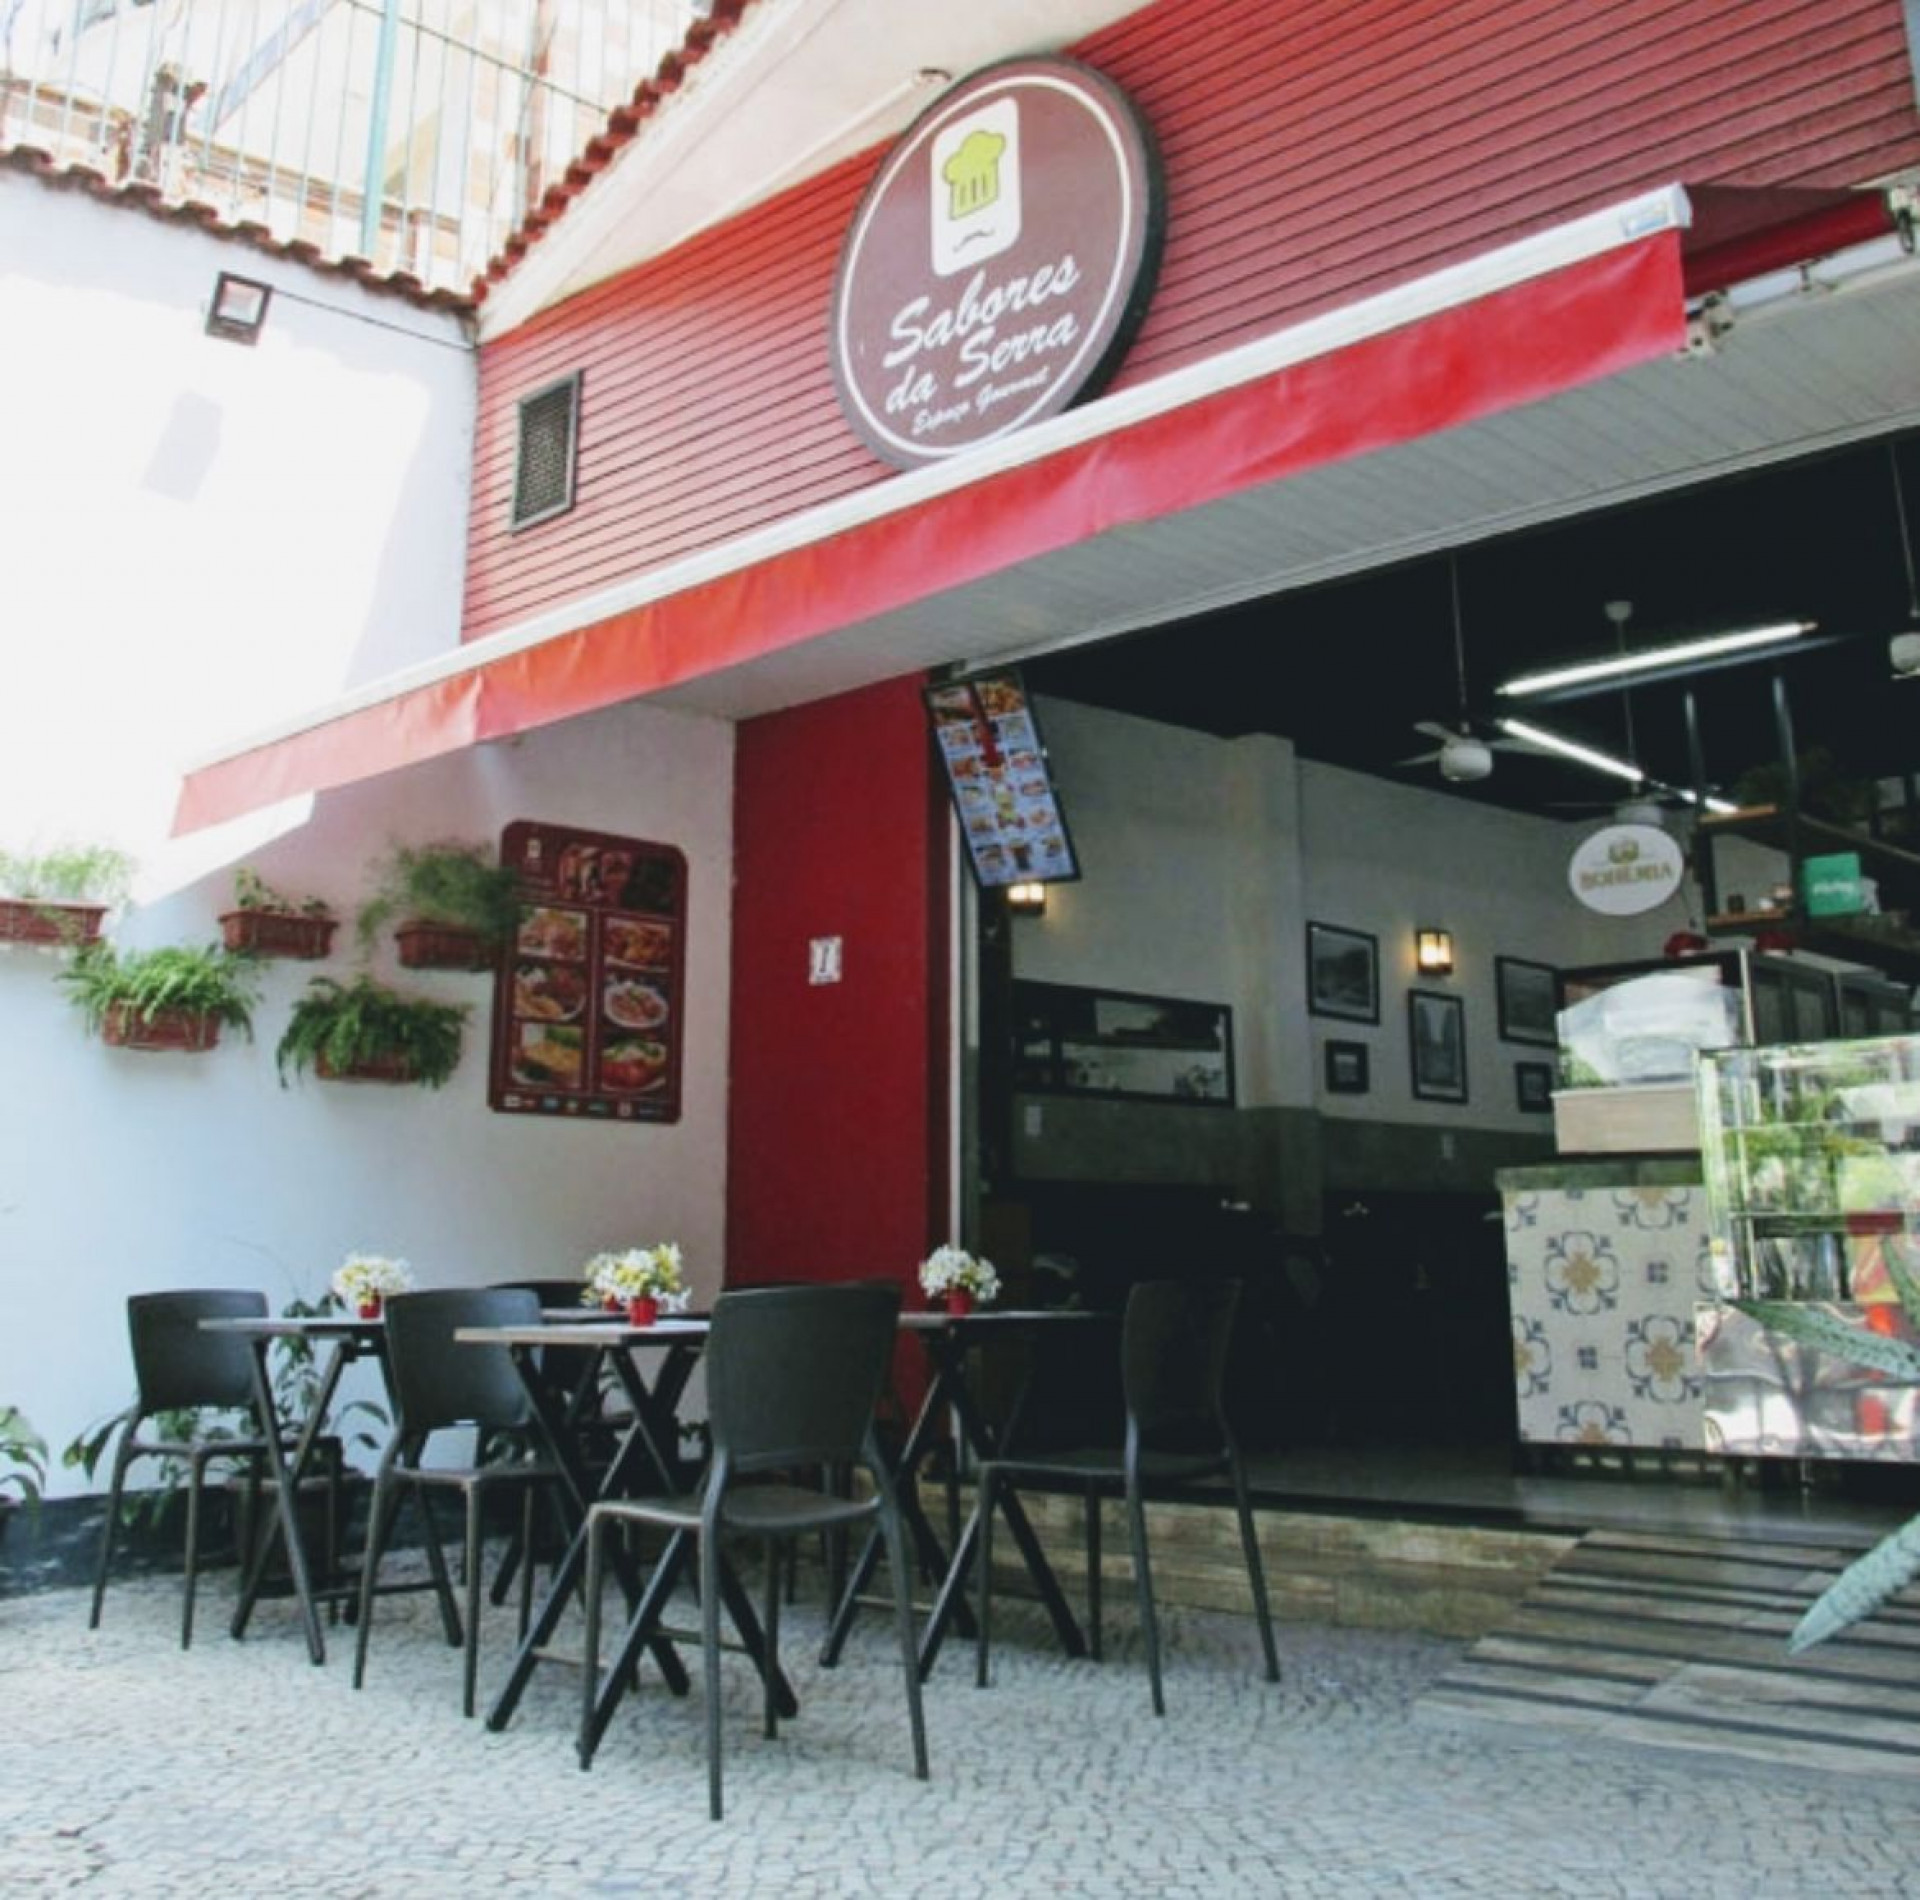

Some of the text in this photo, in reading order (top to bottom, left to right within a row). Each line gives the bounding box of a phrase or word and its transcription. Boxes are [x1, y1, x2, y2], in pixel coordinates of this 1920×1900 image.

[882, 254, 1080, 366] Sabores
[885, 312, 1080, 414] da Serra
